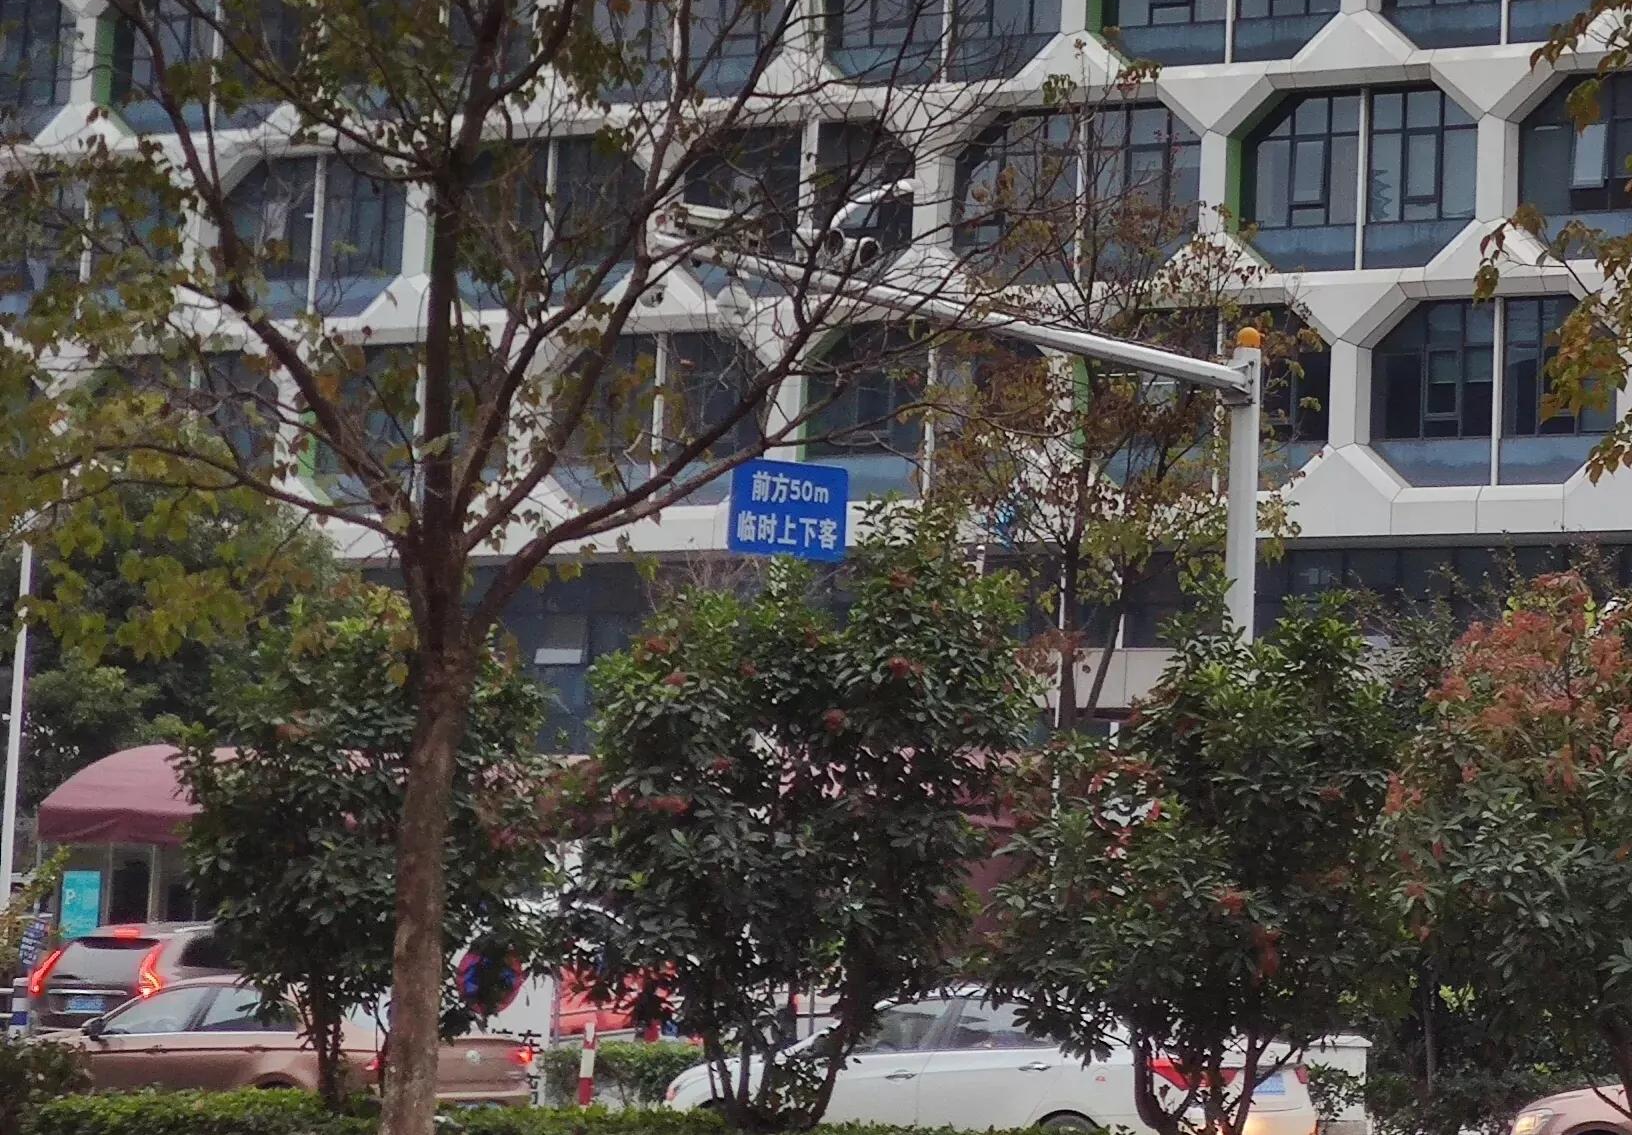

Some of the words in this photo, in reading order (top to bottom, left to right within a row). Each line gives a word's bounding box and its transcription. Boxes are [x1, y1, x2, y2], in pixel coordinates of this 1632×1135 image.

[752, 471, 829, 503] 前方50m
[737, 511, 837, 550] 临时上下客
